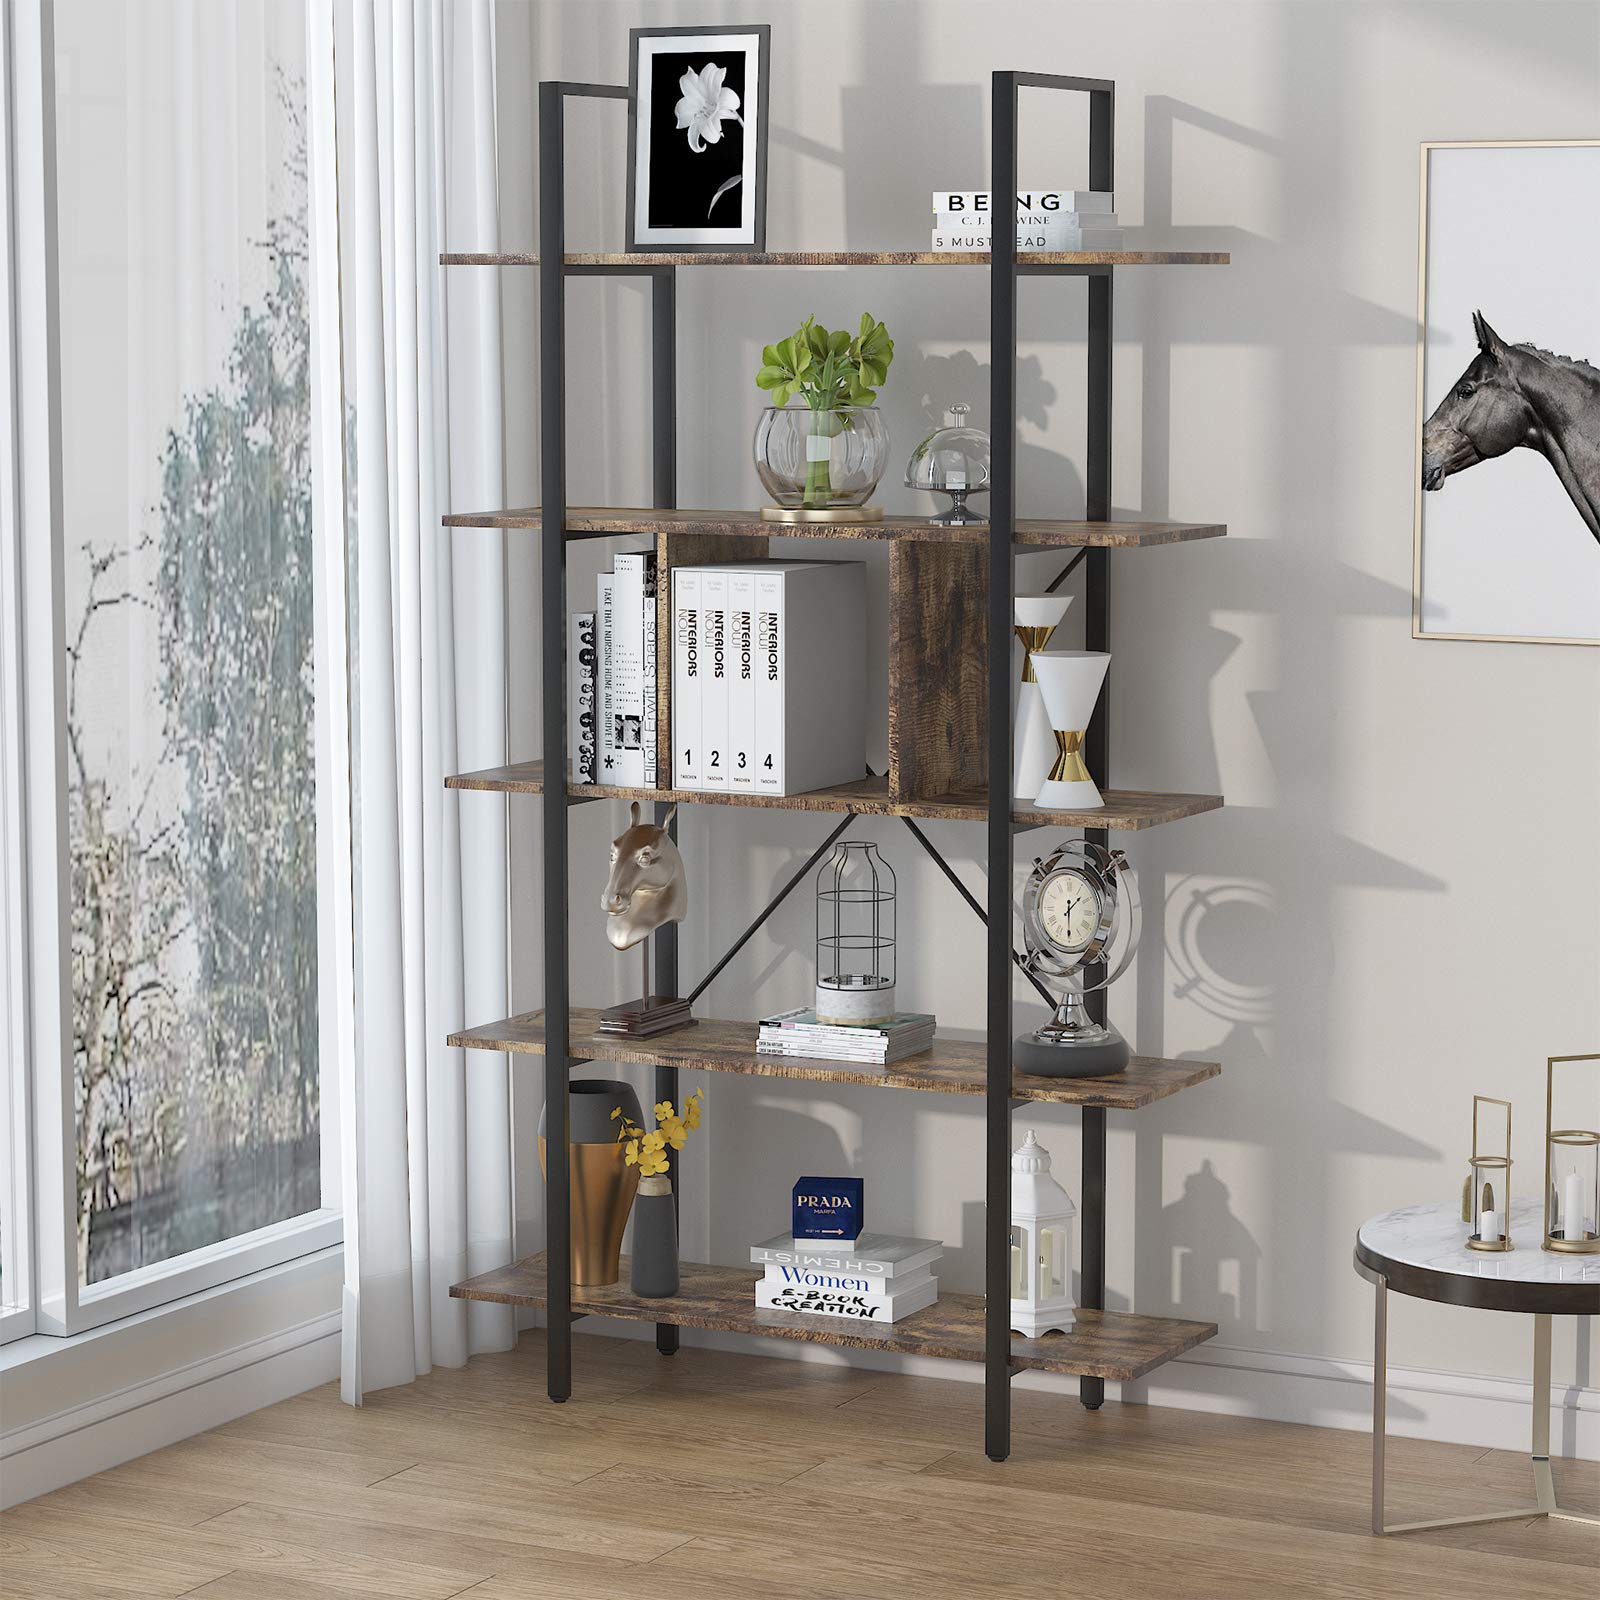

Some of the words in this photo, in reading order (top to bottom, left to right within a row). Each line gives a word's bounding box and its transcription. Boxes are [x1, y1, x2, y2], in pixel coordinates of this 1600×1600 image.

[948, 194, 1060, 212] BENG
[961, 216, 972, 226] C.
[977, 216, 985, 227] J.
[936, 238, 943, 247] 5
[604, 587, 612, 605] TAKE
[604, 609, 612, 628] THAT
[604, 630, 612, 666] NURSING
[643, 621, 656, 677] Snaps
[688, 610, 697, 677] INTERIORS
[714, 611, 724, 678] INTERIORS
[741, 612, 750, 679] INTERIORS
[768, 613, 778, 681] INTERIORS
[604, 668, 612, 690] HOME
[604, 693, 612, 710] AND
[604, 711, 613, 737] SHOVE
[644, 738, 656, 784] Elliott
[684, 749, 691, 765] 1
[710, 751, 719, 767] 2
[737, 752, 746, 768] 3
[763, 754, 773, 770] 4
[797, 1195, 852, 1208] PRADA
[759, 1251, 884, 1273] CHEMIST
[780, 1265, 869, 1292] Women
[770, 1297, 881, 1318] CREATION
[781, 1288, 869, 1308] E-BOOK
